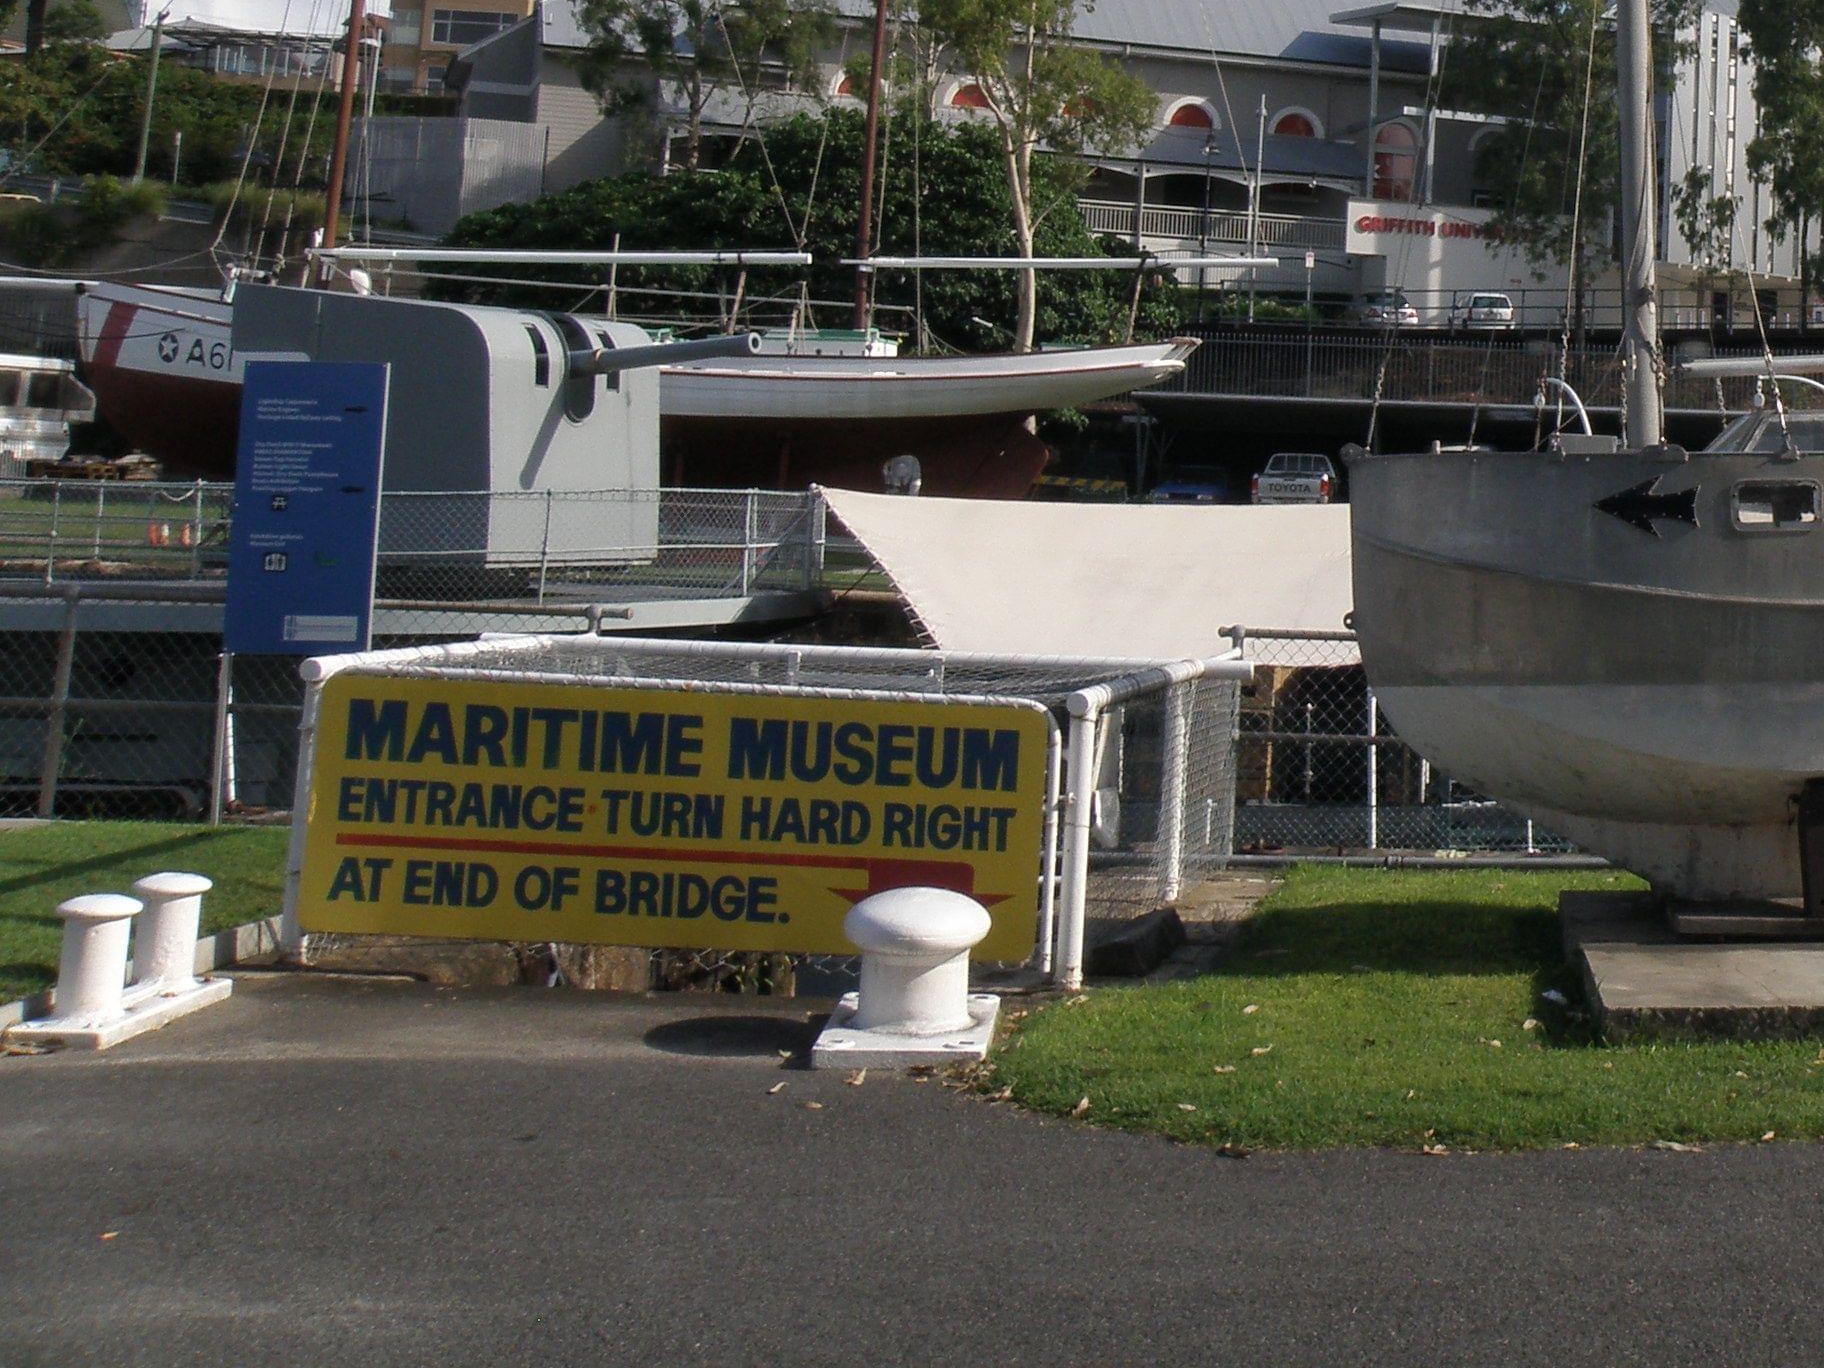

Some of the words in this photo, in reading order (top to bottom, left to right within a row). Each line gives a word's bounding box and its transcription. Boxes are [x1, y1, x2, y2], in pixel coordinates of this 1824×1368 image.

[1356, 215, 1436, 236] GRIFFITH
[1267, 483, 1312, 493] TOYOTA
[345, 698, 704, 778] MARITIME
[727, 717, 1021, 793] MUSEUM
[337, 776, 586, 832] ENTRANCE
[601, 789, 725, 839] TURN
[740, 796, 871, 845] HARD
[882, 802, 1017, 852] RIGHT
[326, 856, 394, 903] AT
[402, 859, 499, 908] END
[514, 865, 580, 912] OF
[594, 869, 791, 924] BRIDGE.
